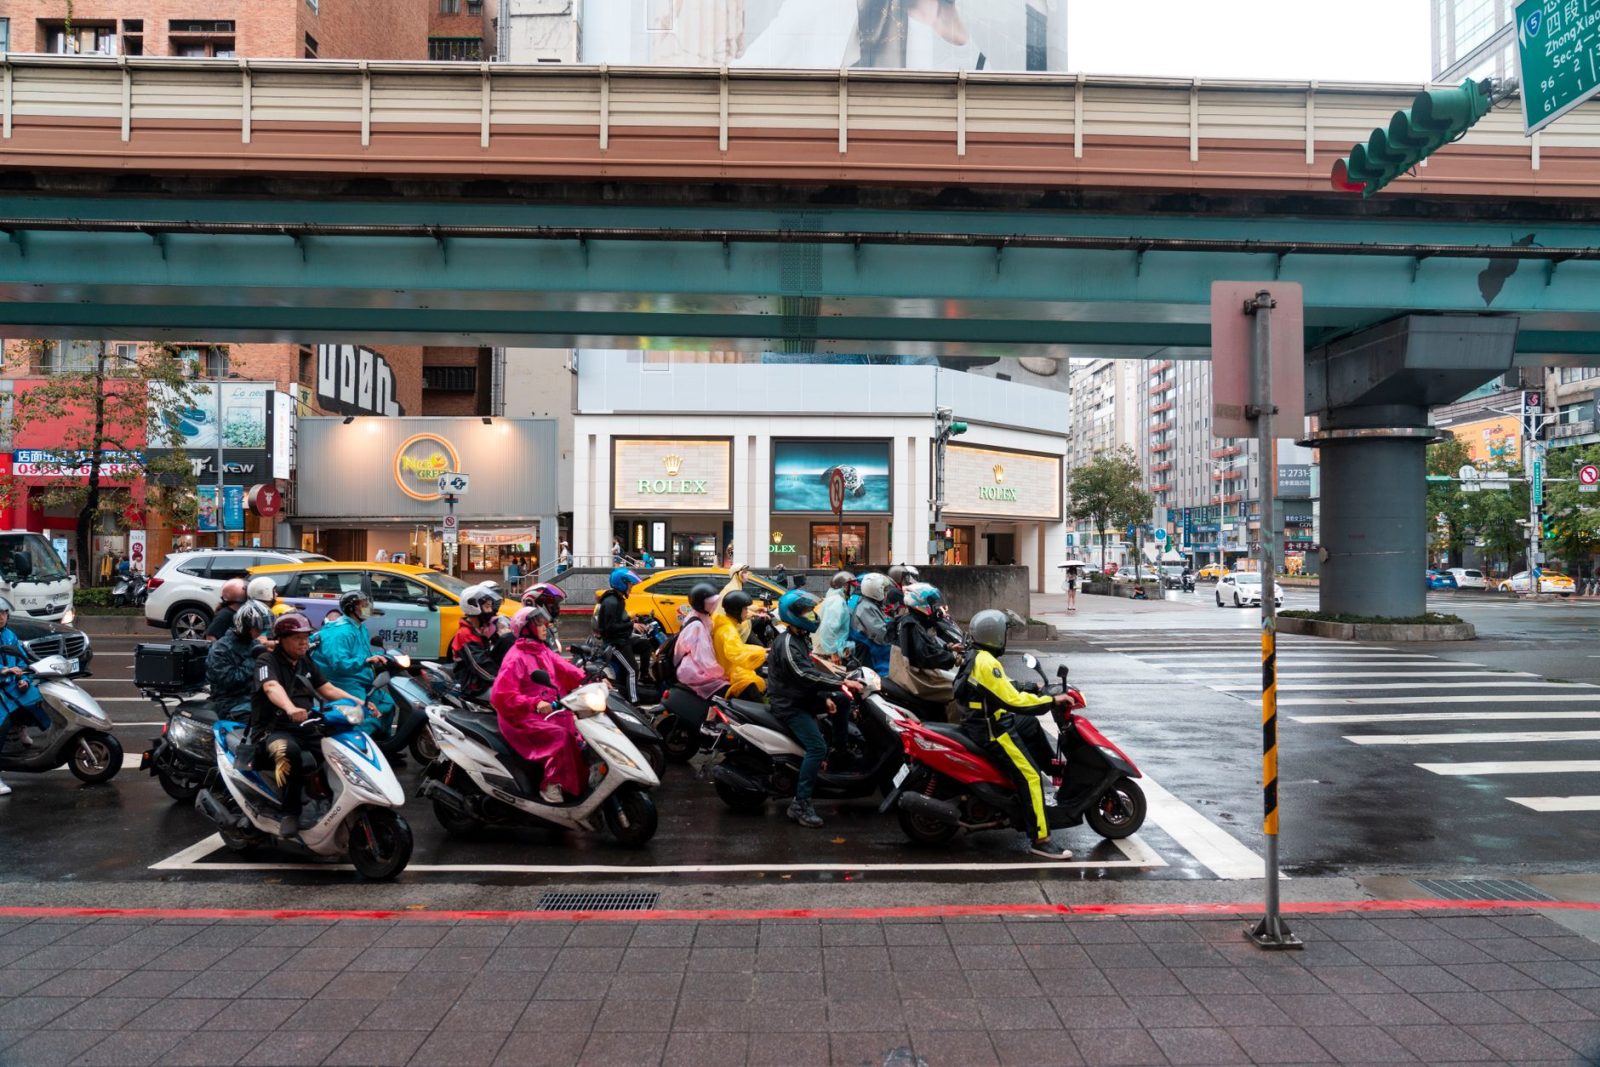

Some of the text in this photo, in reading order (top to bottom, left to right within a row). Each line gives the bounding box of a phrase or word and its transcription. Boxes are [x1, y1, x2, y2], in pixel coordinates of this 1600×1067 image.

[1530, 16, 1538, 30] 5
[637, 479, 707, 494] ROLEX
[979, 486, 1017, 502] ROLEX
[769, 545, 796, 553] OLEX
